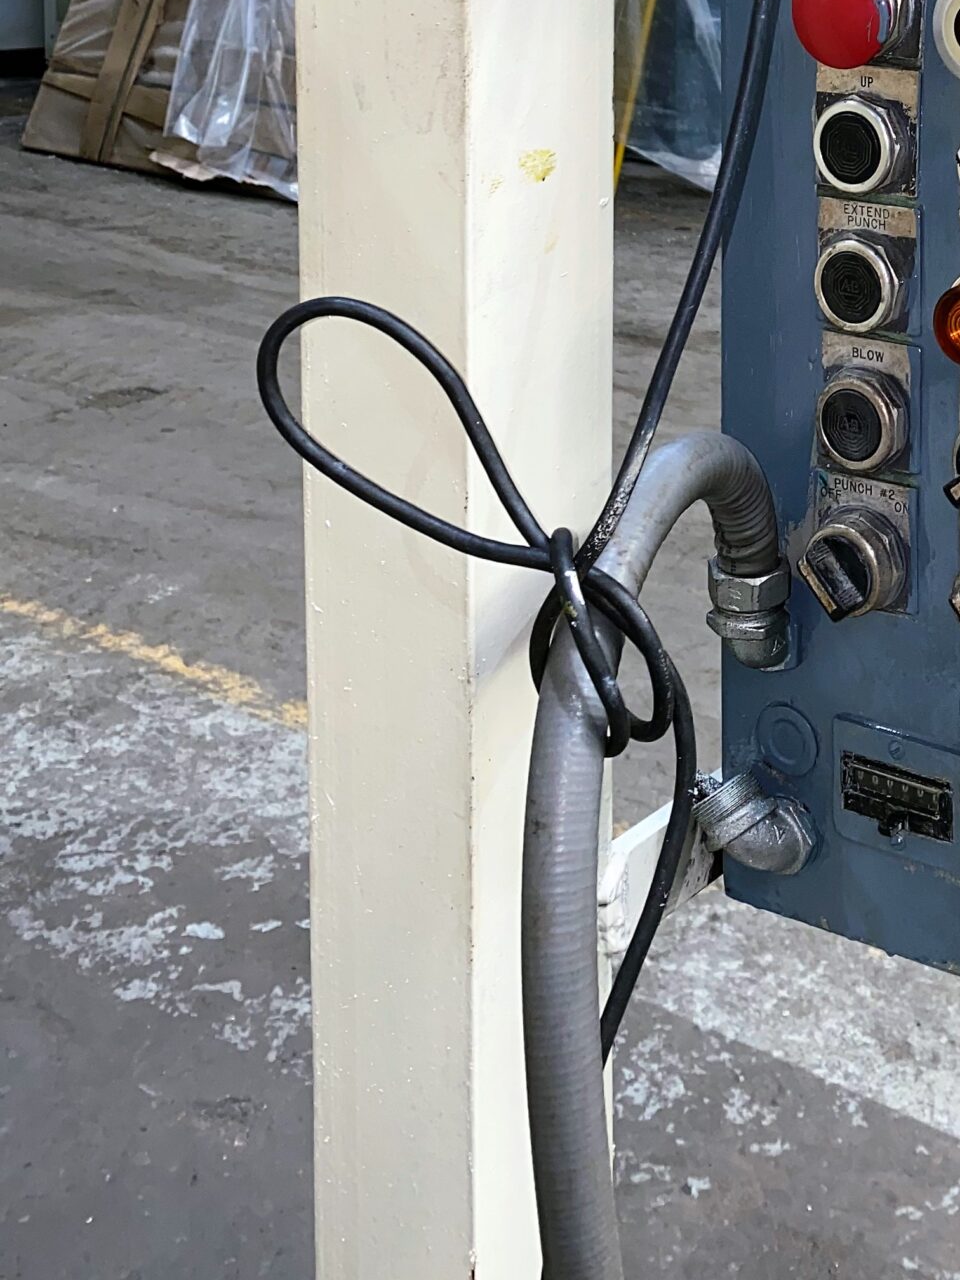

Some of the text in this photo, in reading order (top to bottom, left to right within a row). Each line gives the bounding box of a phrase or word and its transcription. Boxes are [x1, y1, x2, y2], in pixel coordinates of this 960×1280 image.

[861, 76, 874, 88] UP
[844, 204, 890, 219] EXTEND
[848, 216, 886, 230] PUNCH
[852, 347, 884, 363] BLOW
[821, 486, 841, 501] OFF
[834, 478, 873, 496] PUNCH
